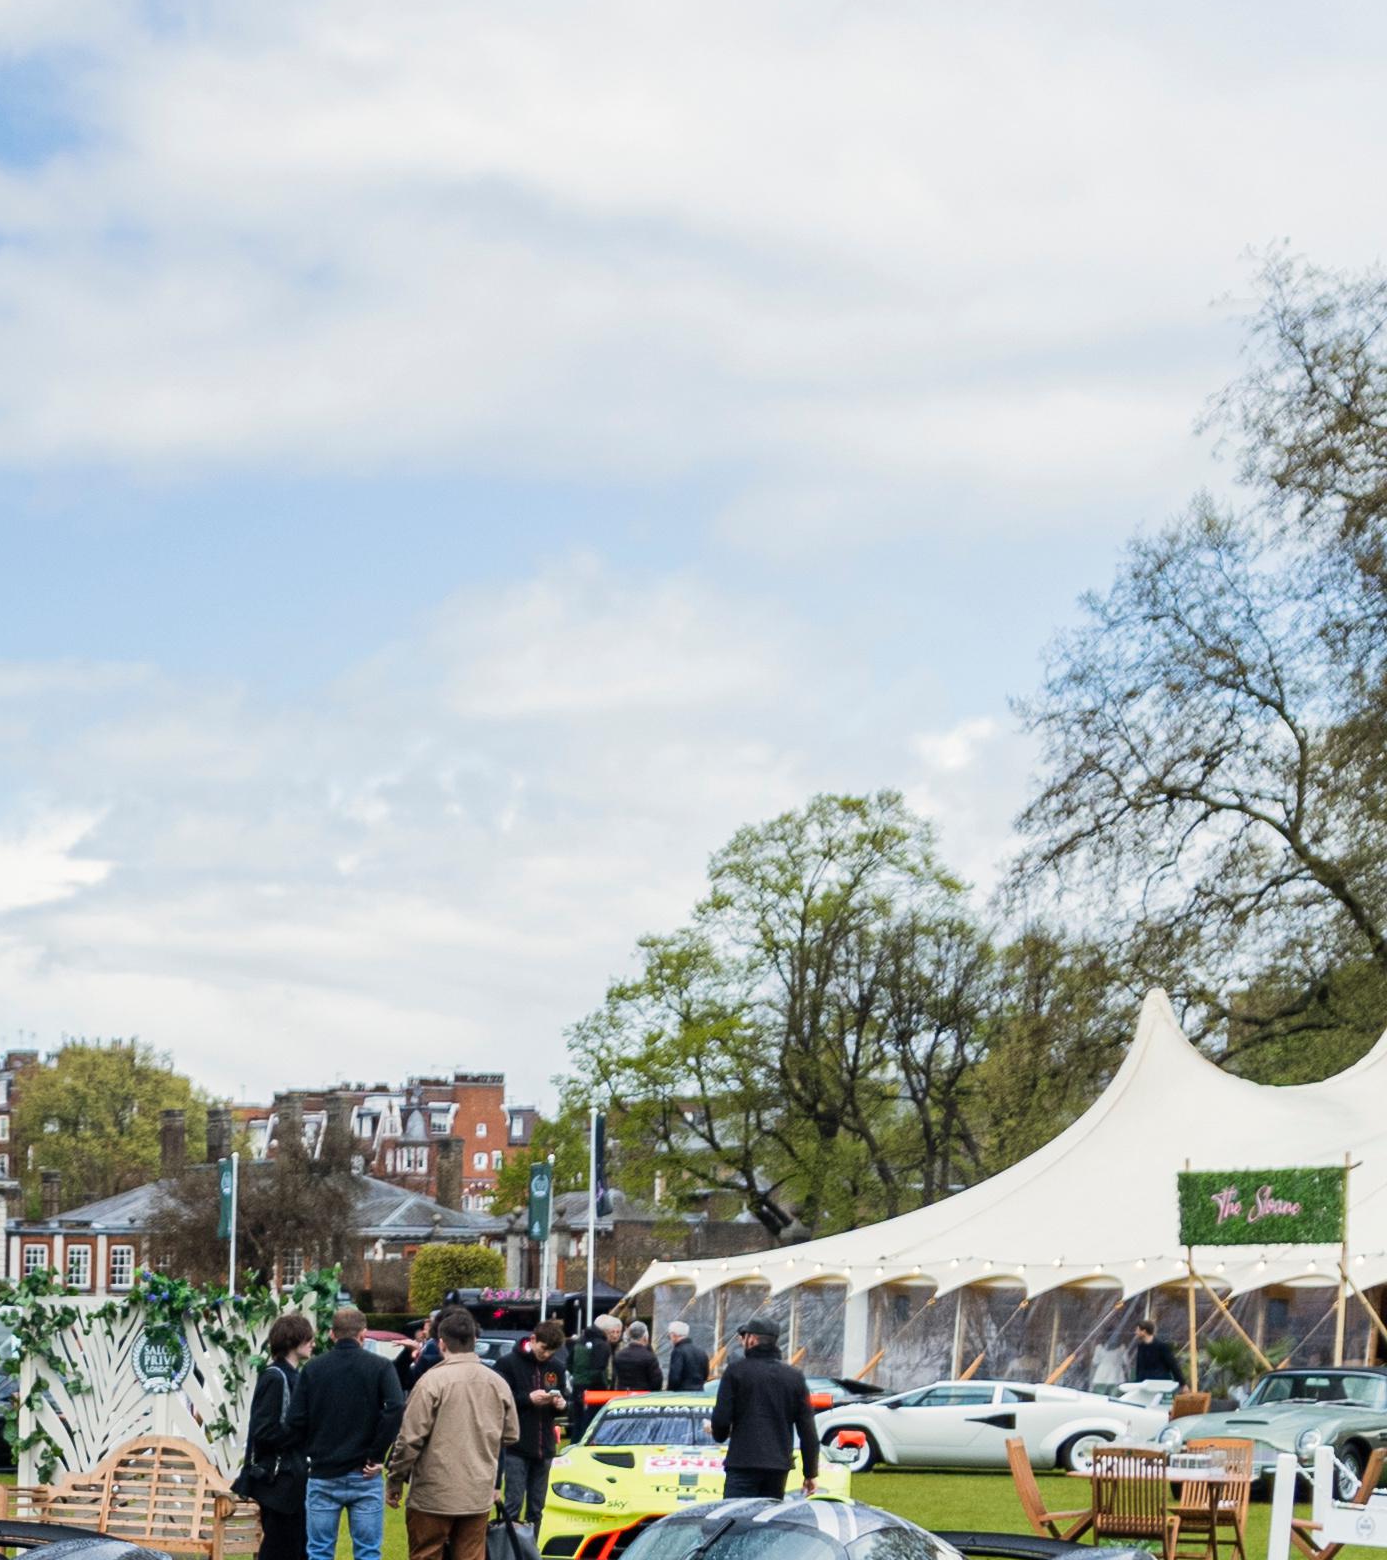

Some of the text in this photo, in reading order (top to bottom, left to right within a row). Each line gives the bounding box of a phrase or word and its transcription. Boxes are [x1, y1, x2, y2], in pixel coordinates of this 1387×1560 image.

[1211, 1184, 1243, 1225] The
[144, 1344, 169, 1355] SALO
[607, 1500, 628, 1510] sky
